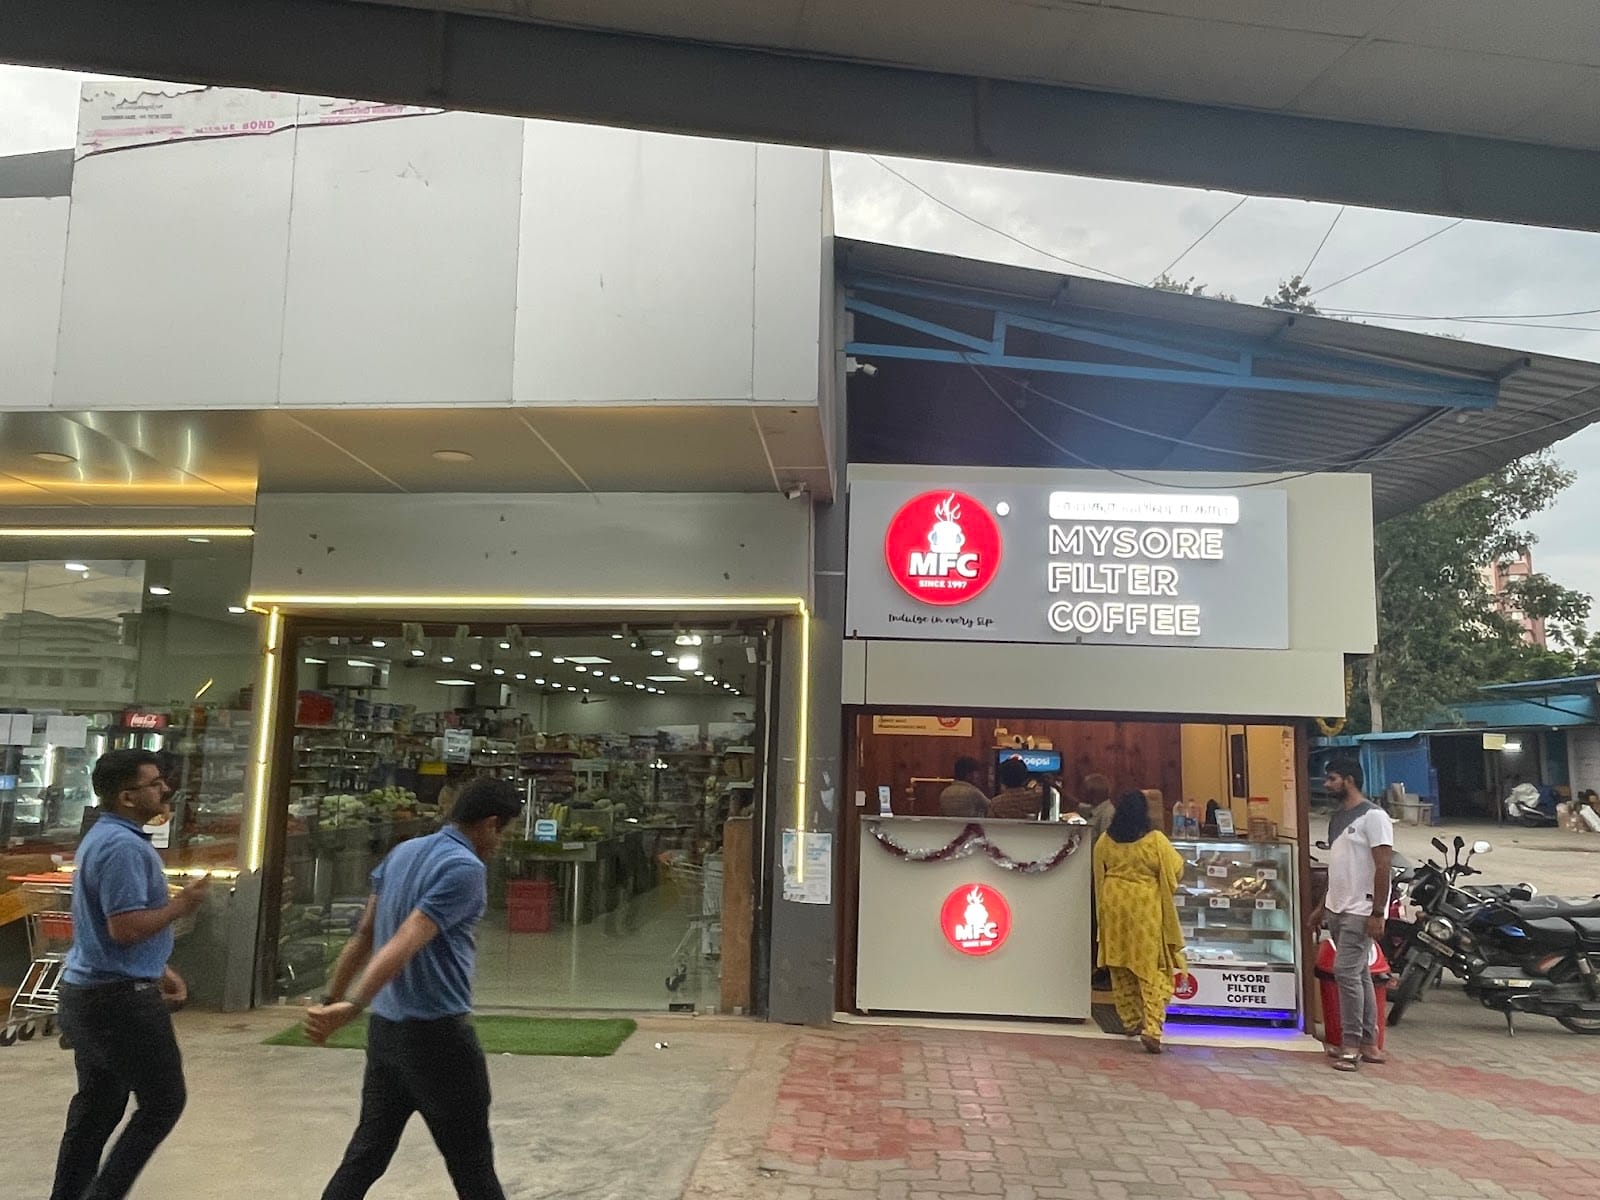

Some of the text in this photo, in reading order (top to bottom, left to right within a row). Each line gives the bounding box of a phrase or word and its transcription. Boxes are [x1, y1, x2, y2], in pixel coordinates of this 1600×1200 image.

[242, 120, 275, 130] BOND
[1049, 525, 1223, 559] MYSORE
[908, 552, 980, 578] MFC
[918, 580, 946, 588] SINCE
[1048, 562, 1179, 595] FILTER
[1048, 601, 1200, 636] COFFEE
[955, 922, 998, 941] MFC
[1222, 973, 1271, 984] MYSORE
[1227, 984, 1266, 994] FILTER
[1227, 994, 1267, 1004] COFFEE
